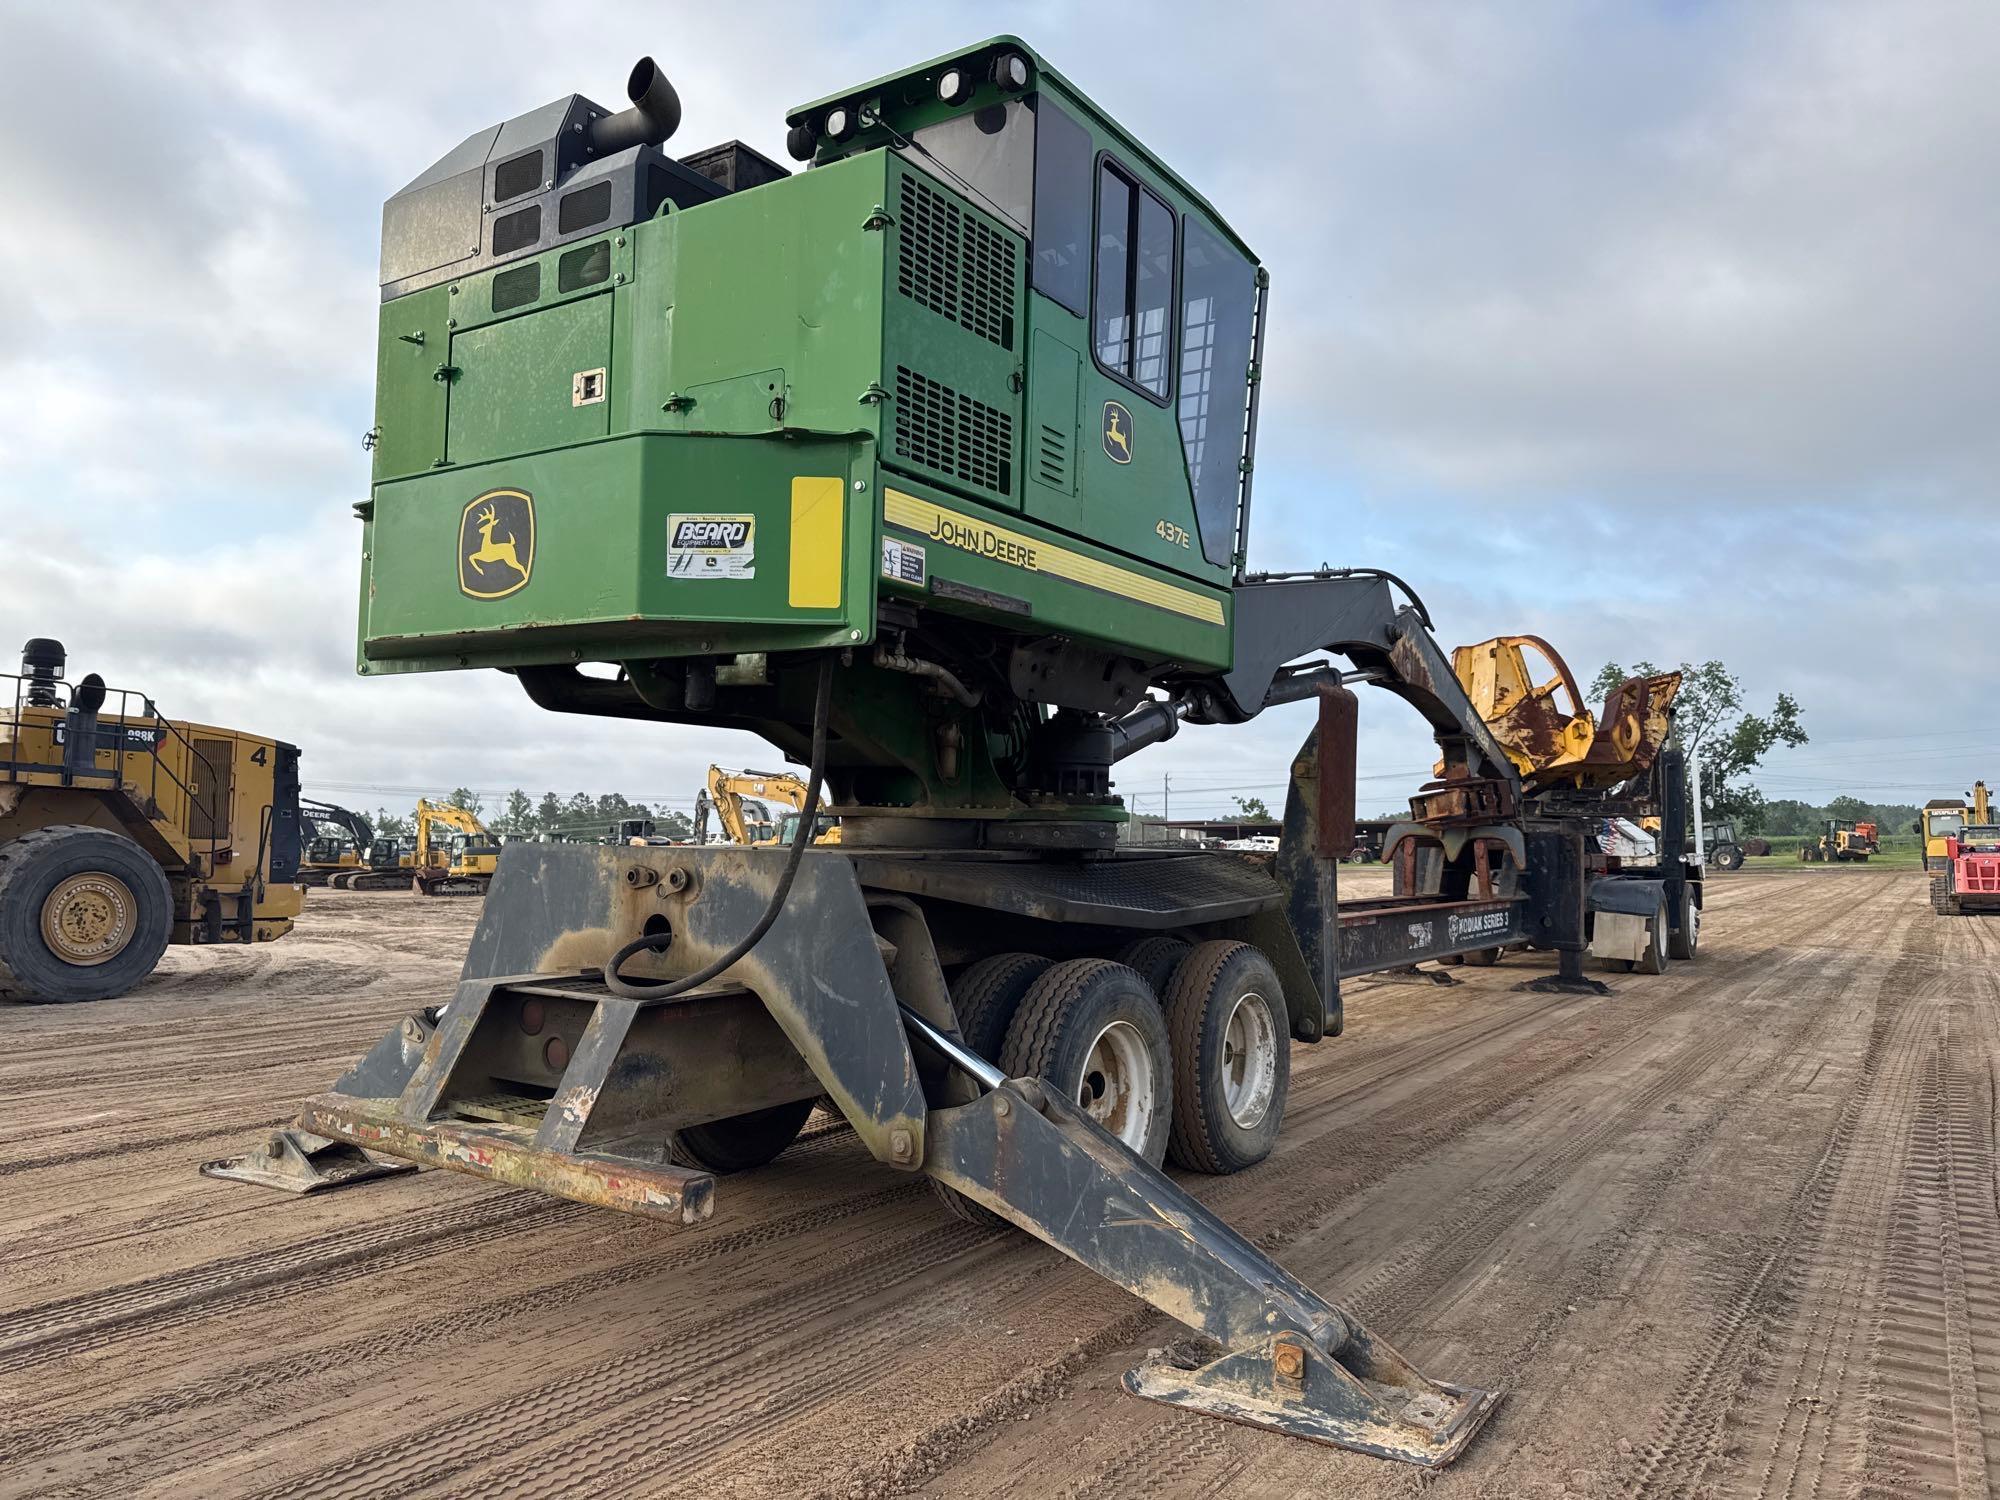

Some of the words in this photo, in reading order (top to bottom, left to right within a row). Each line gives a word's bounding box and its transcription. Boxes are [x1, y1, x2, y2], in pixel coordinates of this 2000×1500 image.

[677, 522, 745, 548] BEARD
[930, 514, 980, 551] JOHN
[983, 530, 1038, 569] DEERE
[1156, 519, 1190, 550] 437E
[250, 745, 267, 767] 4
[302, 809, 331, 820] DEERE
[1459, 916, 1483, 934] KODIAK
[1484, 912, 1503, 929] SERIES
[1504, 911, 1509, 926] 3
